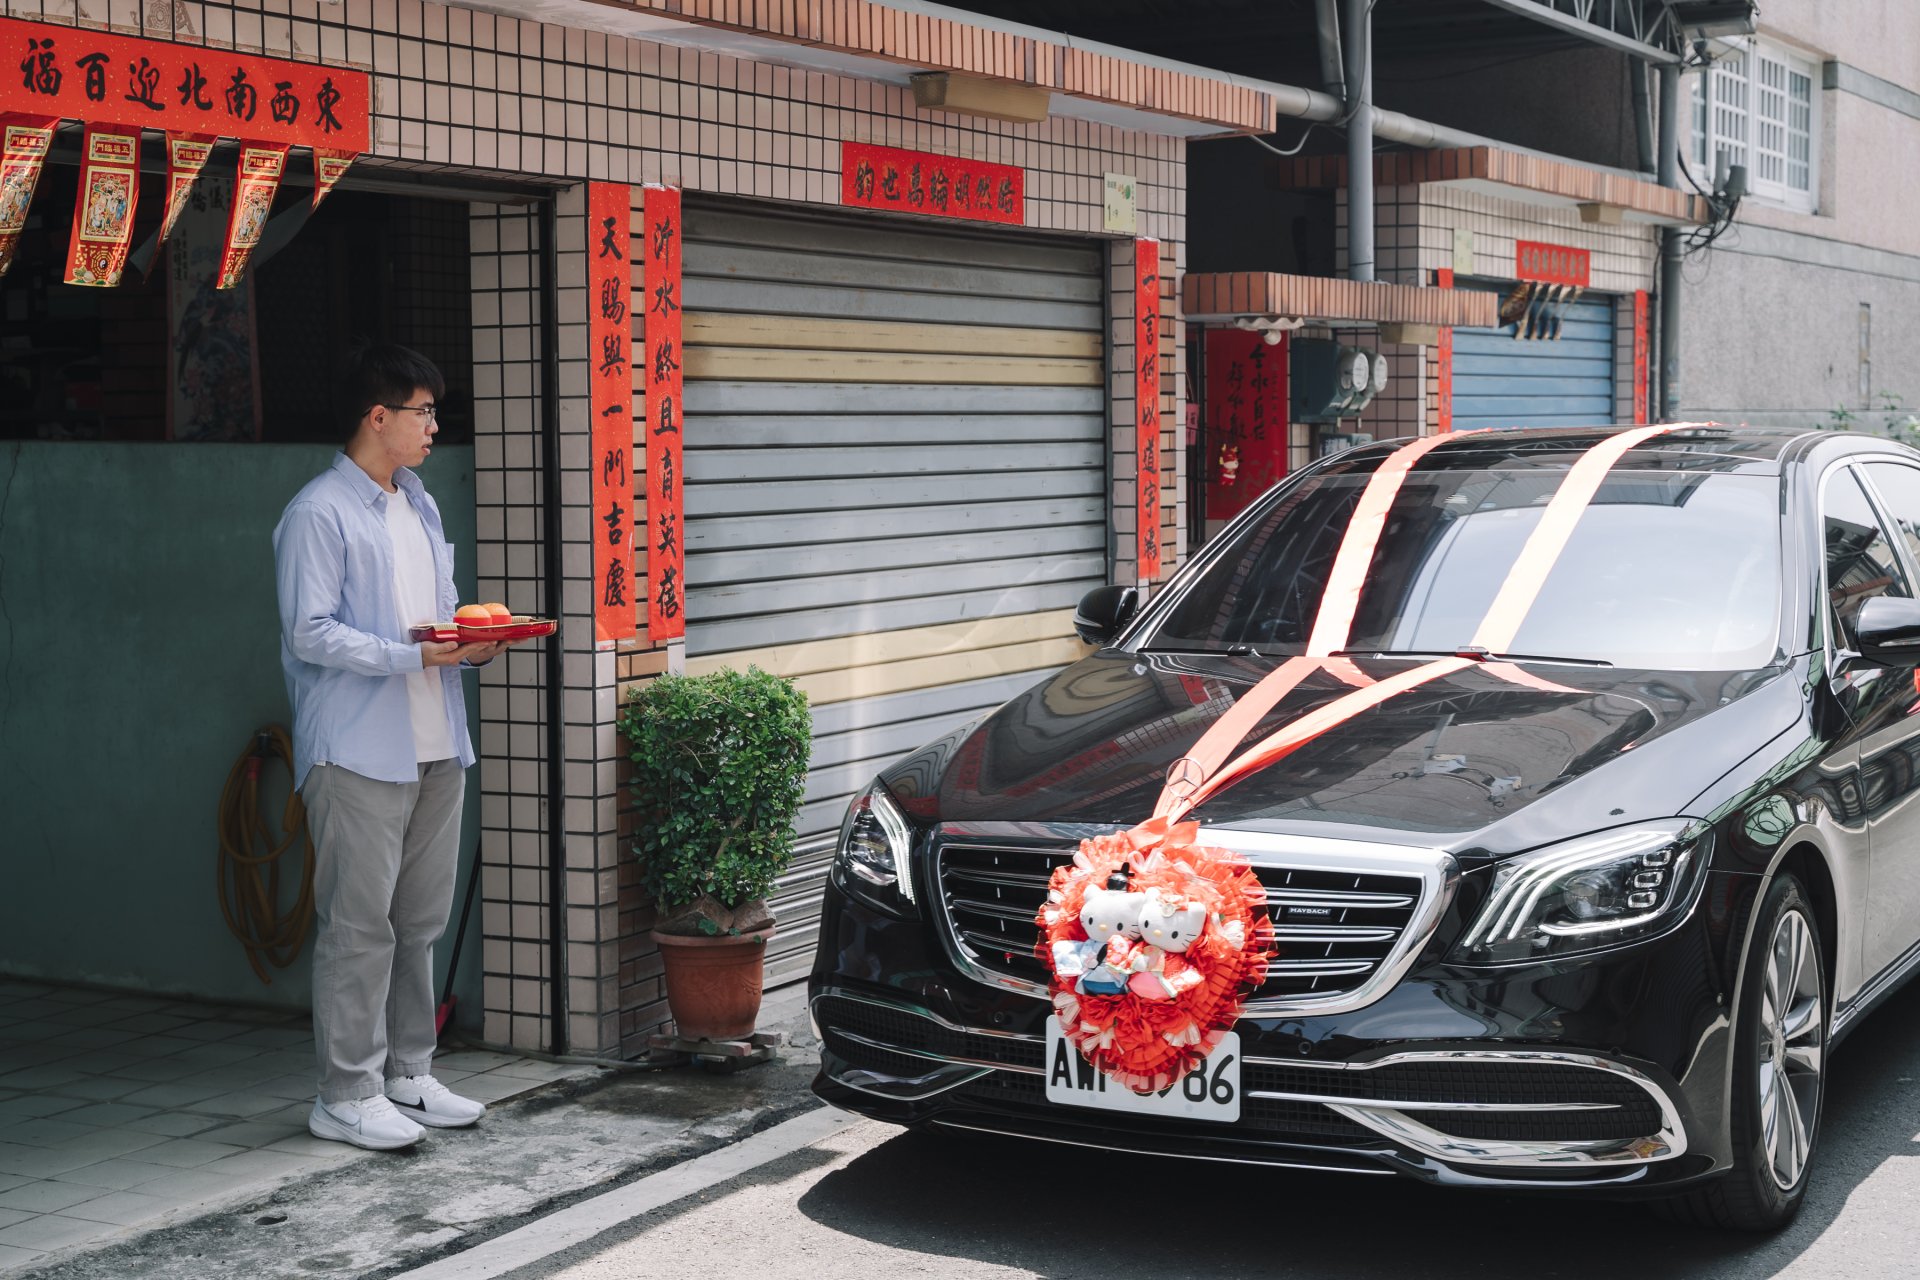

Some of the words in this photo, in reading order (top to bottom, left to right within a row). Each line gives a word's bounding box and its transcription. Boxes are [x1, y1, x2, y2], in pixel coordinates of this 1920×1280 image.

[20, 37, 343, 134] 東西南北迎百福
[1290, 907, 1329, 915] MAYBACH
